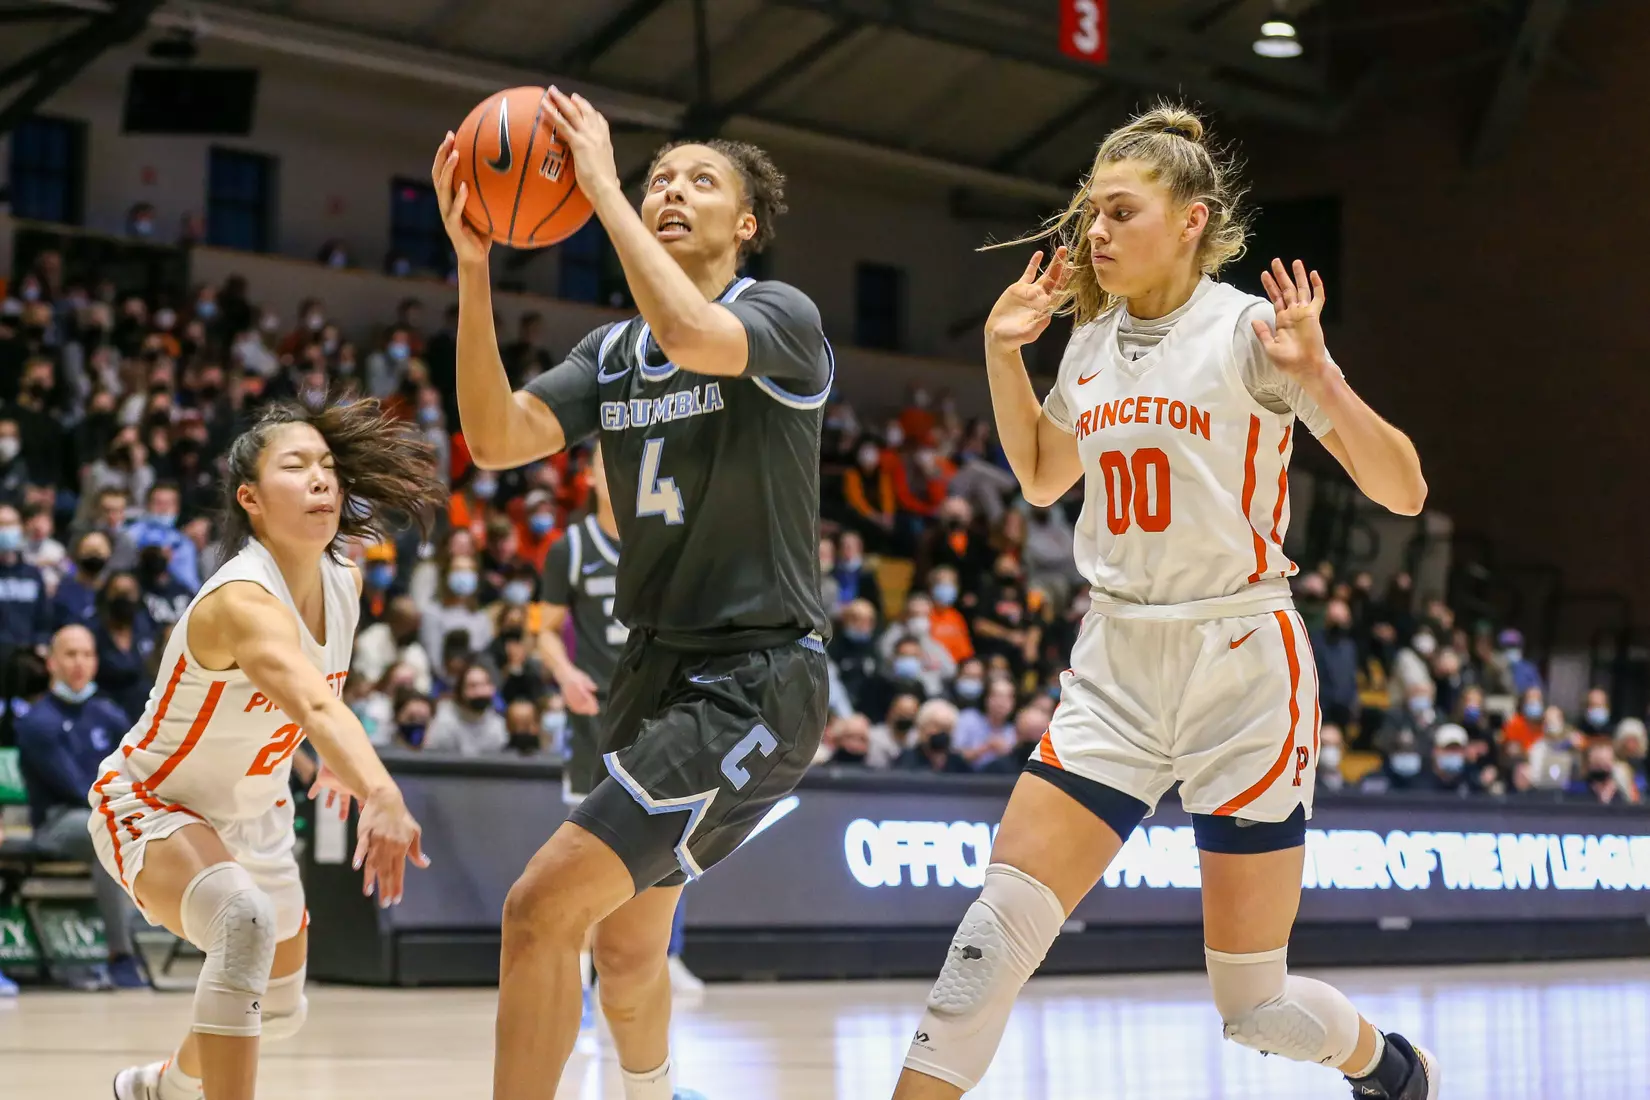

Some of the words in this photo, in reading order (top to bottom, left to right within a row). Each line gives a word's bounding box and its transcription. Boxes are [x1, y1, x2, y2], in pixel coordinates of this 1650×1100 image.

[1072, 0, 1101, 55] 3
[600, 381, 725, 431] COUMBIA
[636, 437, 685, 526] 4
[1099, 447, 1172, 536] 00
[1292, 745, 1309, 787] P
[844, 818, 999, 889] OFFICI
